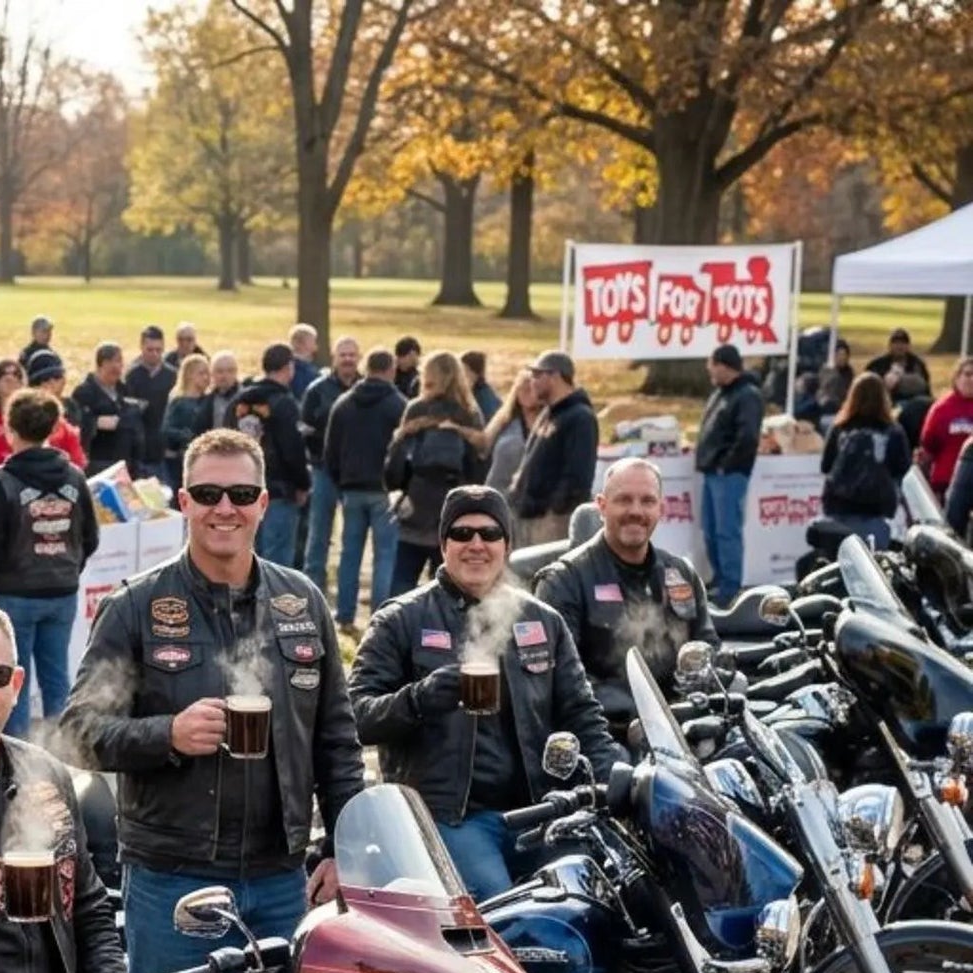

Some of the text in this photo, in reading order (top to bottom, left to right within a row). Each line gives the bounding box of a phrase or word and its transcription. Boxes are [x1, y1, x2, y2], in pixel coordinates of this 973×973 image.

[587, 271, 768, 326] TOYS FOR TOTS
